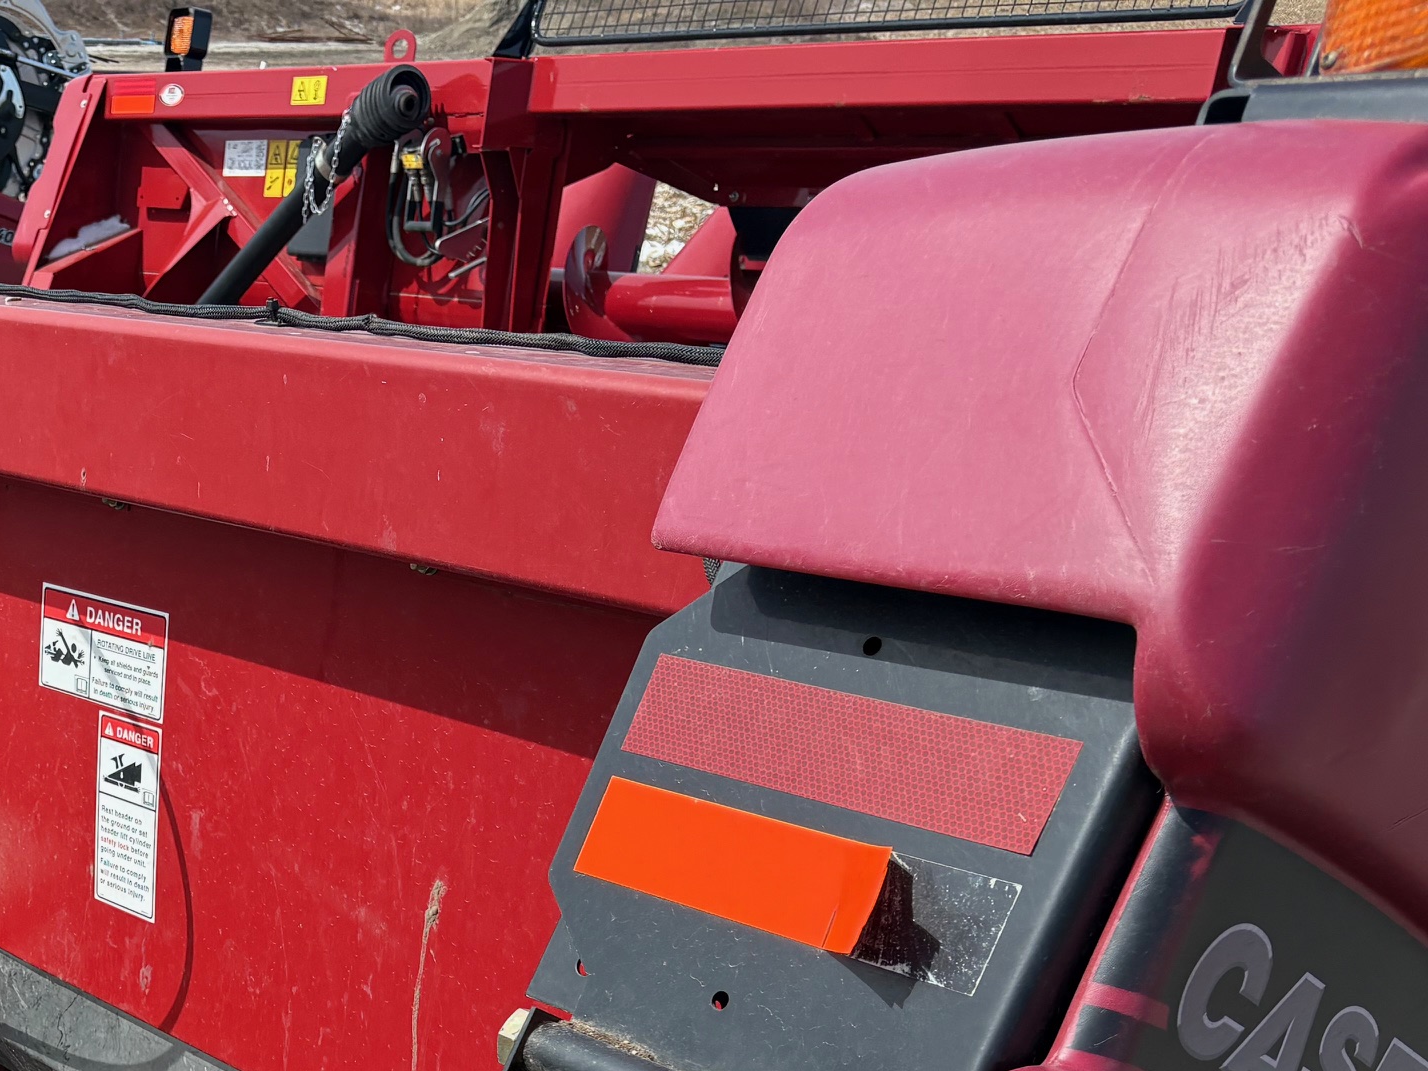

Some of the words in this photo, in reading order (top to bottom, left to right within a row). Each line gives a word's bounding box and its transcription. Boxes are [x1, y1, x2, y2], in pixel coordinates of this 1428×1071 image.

[86, 607, 142, 636] DANGER
[97, 639, 123, 652] ROTATING
[125, 646, 141, 657] DRIVE
[143, 652, 155, 661] LINE
[98, 656, 109, 665] Keep
[117, 662, 132, 671] shields
[143, 669, 158, 678] guards
[92, 677, 108, 689] Failure
[115, 684, 133, 696] comply
[134, 688, 143, 697] will
[143, 691, 158, 702] result
[99, 689, 113, 699] death
[120, 696, 138, 706] serious
[116, 727, 153, 748] DANGER
[102, 805, 114, 815] Rest
[115, 809, 133, 822] header
[101, 815, 109, 823] the
[111, 819, 130, 831] ground
[139, 830, 148, 838] set
[101, 825, 119, 837] header
[120, 832, 128, 841] lift
[129, 836, 151, 849] cylinder
[101, 836, 116, 847] safety
[117, 842, 129, 851] lock
[131, 846, 148, 859] before
[101, 846, 115, 857] going
[116, 851, 132, 863] under
[101, 857, 118, 870] Failure
[120, 865, 126, 873] to
[126, 869, 146, 883] comply
[107, 881, 126, 893] serious
[110, 873, 126, 883] result
[134, 881, 149, 892] death
